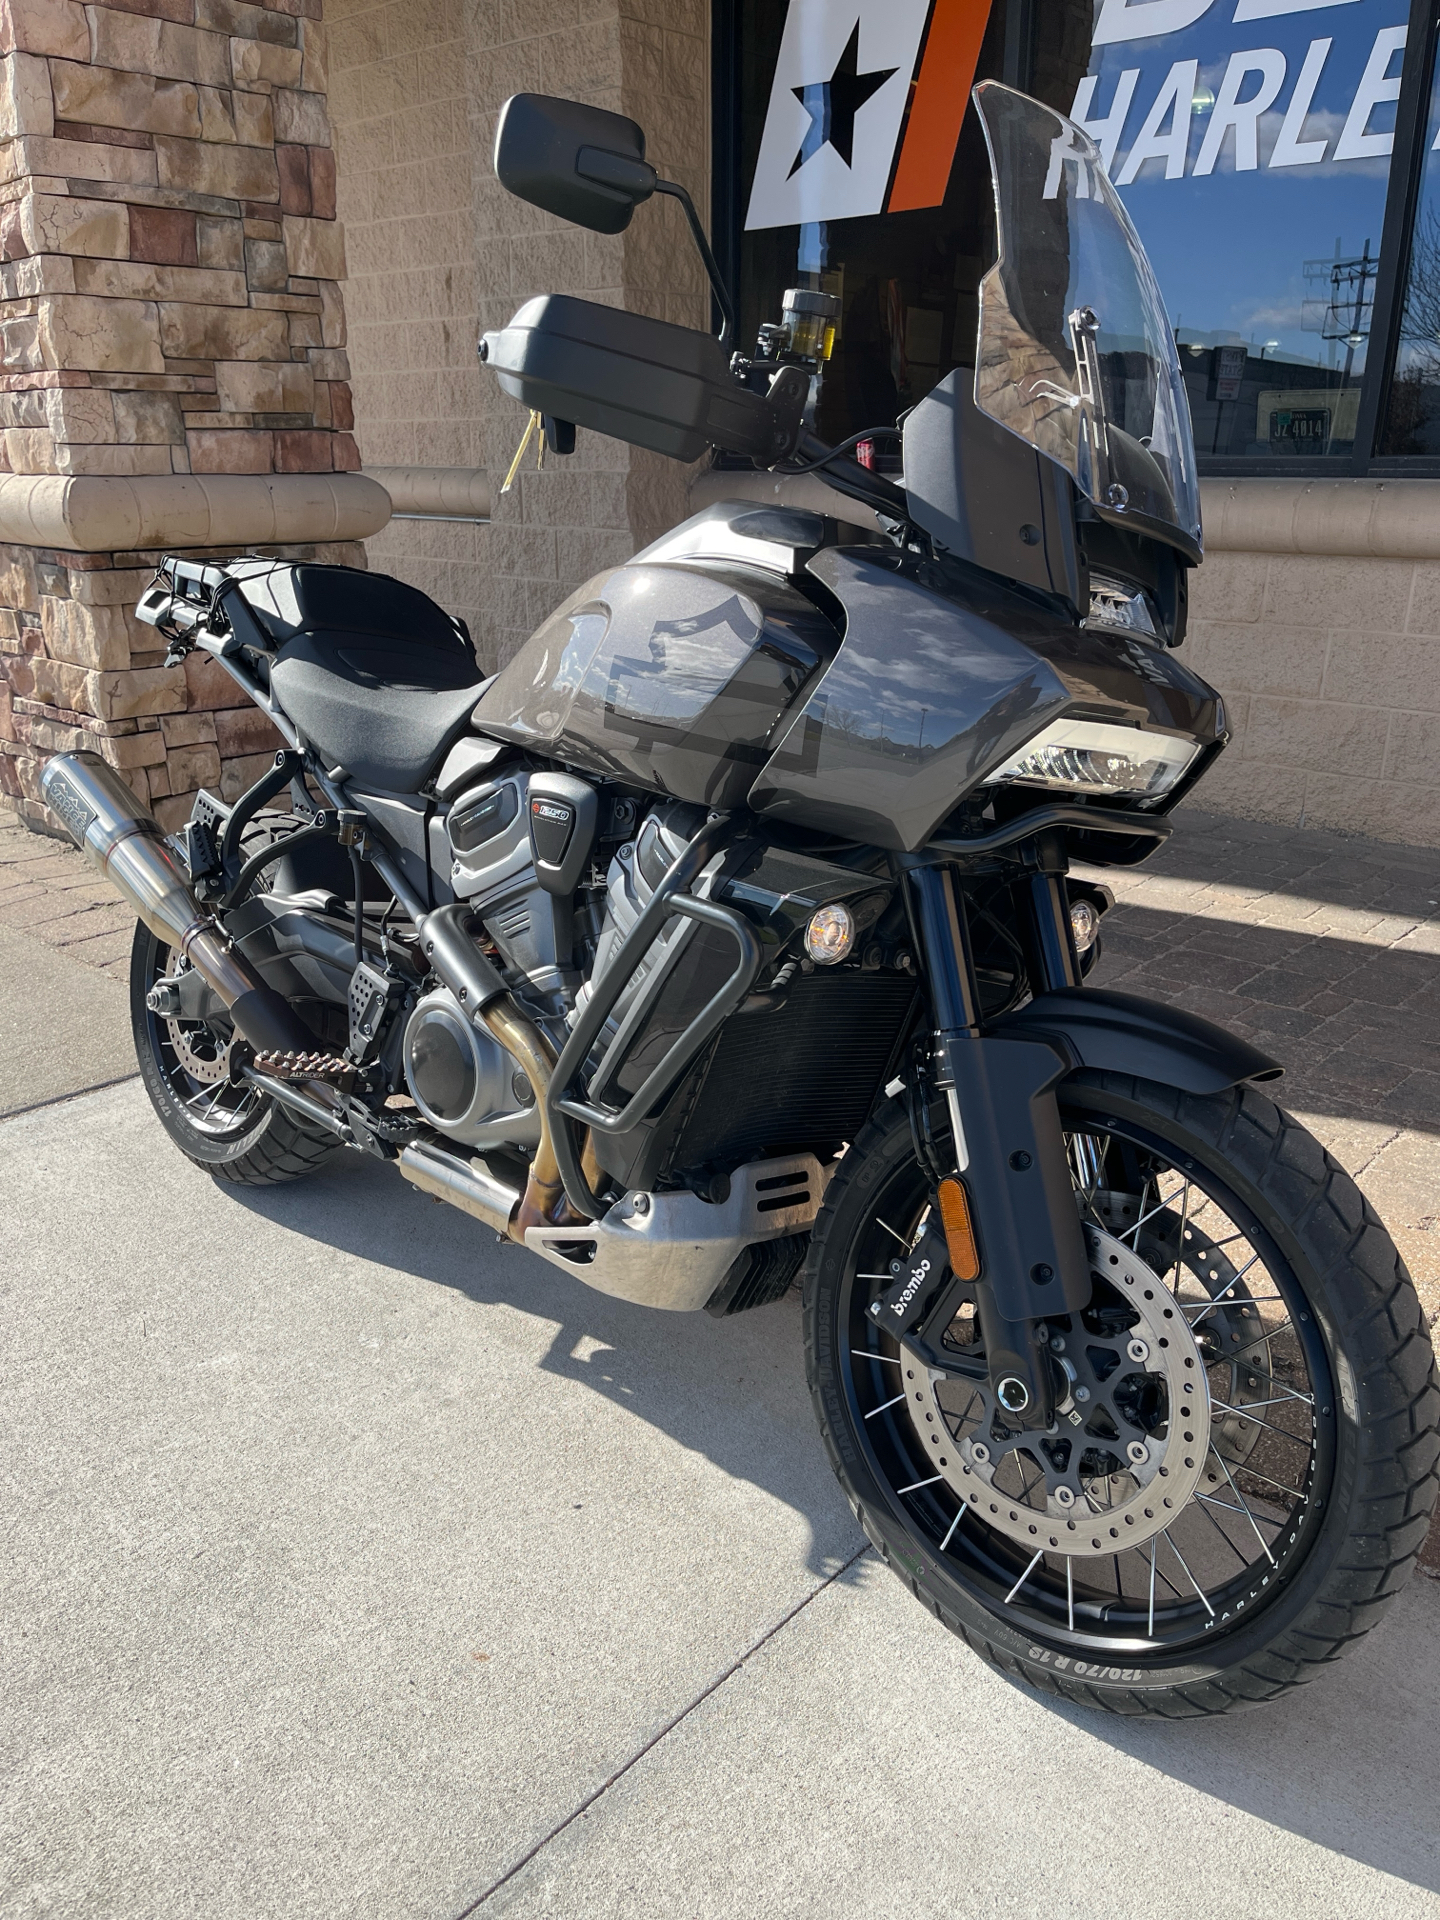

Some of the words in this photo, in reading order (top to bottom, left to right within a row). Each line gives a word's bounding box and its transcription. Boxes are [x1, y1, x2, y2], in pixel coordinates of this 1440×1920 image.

[1043, 19, 1440, 201] HARLE
[1293, 419, 1322, 437] 4014
[49, 785, 87, 827] VANCE
[539, 805, 570, 821] 1250
[289, 1071, 325, 1080] ALTRIDER
[890, 1258, 932, 1317] brembo
[1053, 1656, 1071, 1671] R
[1074, 1662, 1142, 1682] 120/70
